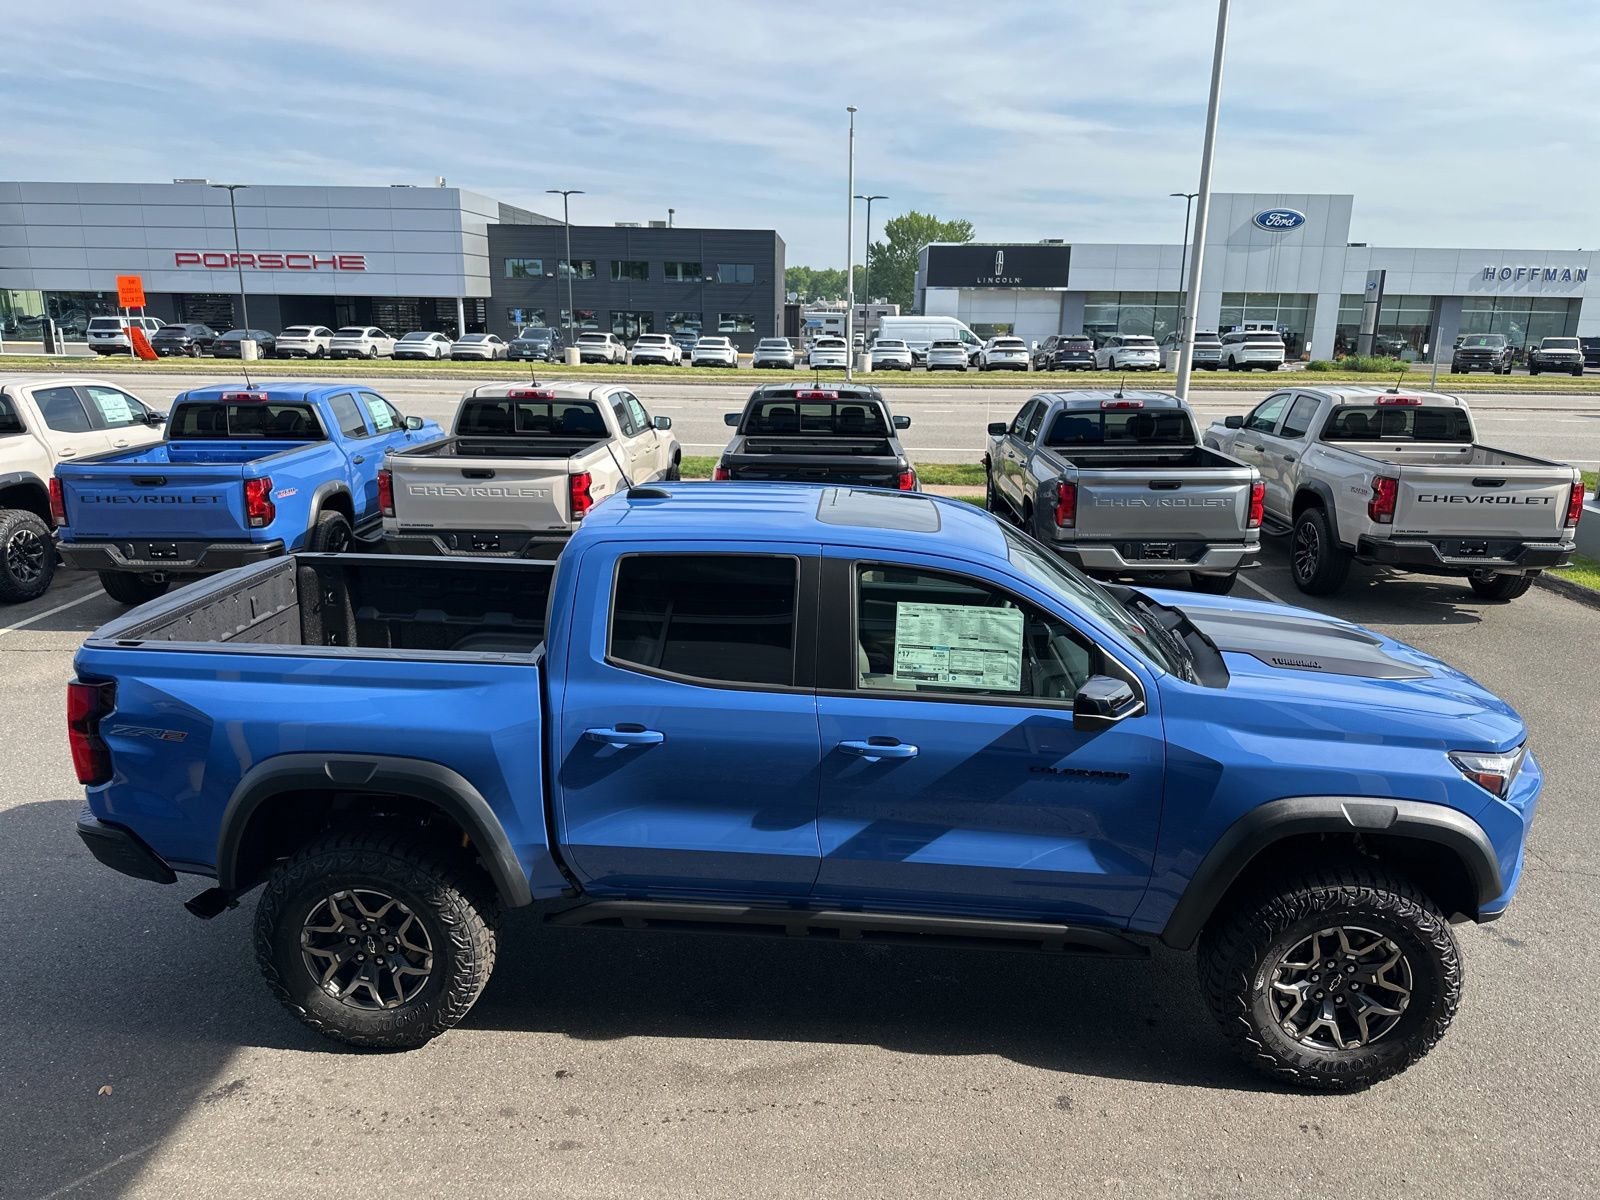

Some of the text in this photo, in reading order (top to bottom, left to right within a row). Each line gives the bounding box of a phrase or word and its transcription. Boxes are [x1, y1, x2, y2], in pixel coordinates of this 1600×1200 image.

[1266, 213, 1296, 226] Ford
[175, 252, 367, 270] PORSCHE
[1483, 266, 1588, 282] HOFFMAN
[409, 486, 550, 498] CHEVROLET
[80, 495, 224, 504] CHEVROLET
[1093, 497, 1233, 507] CHEVROLET
[1418, 494, 1554, 505] CHEVROLET
[110, 724, 189, 742] ZR2
